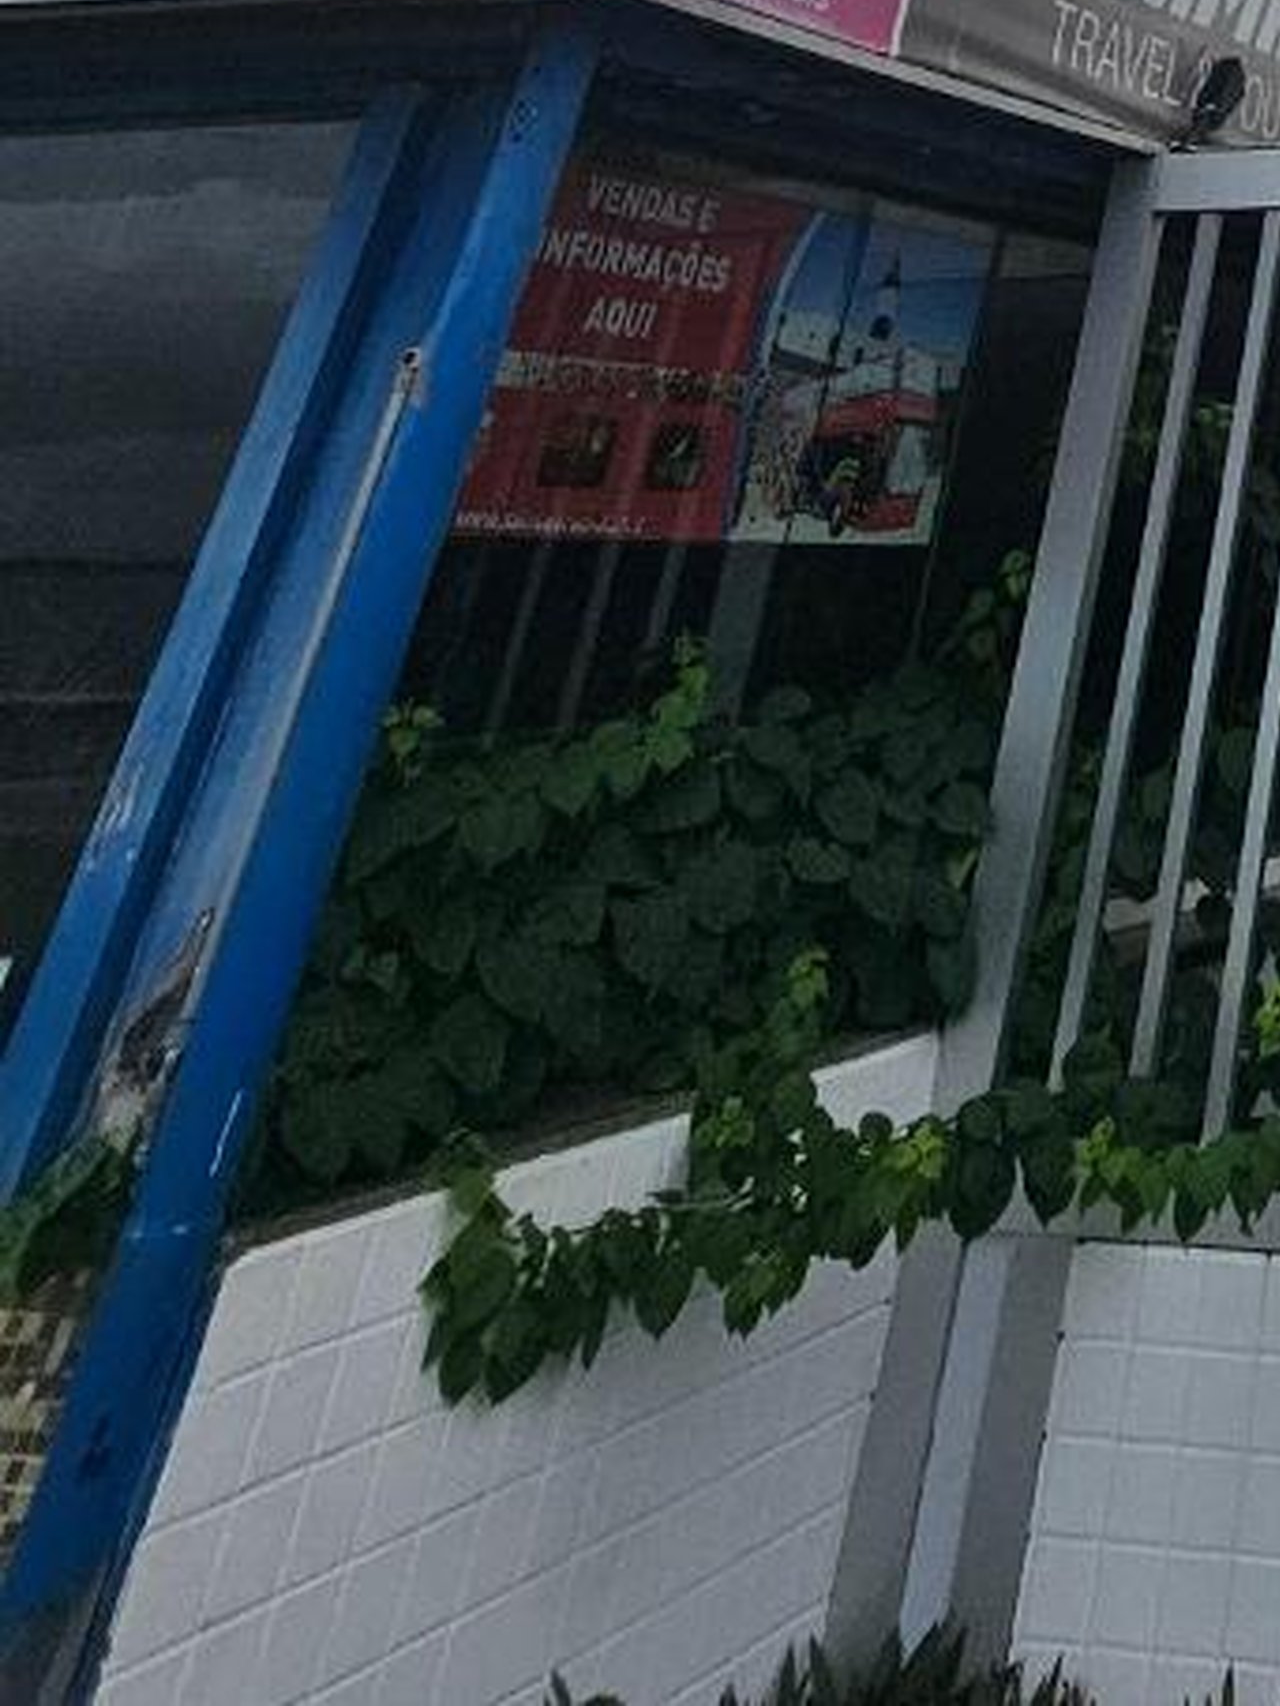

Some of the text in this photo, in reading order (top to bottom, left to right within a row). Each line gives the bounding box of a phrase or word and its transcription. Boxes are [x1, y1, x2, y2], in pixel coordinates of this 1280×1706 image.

[1052, 0, 1183, 108] TRAVEL
[588, 175, 693, 227] VENDAS
[583, 298, 658, 338] AQUI
